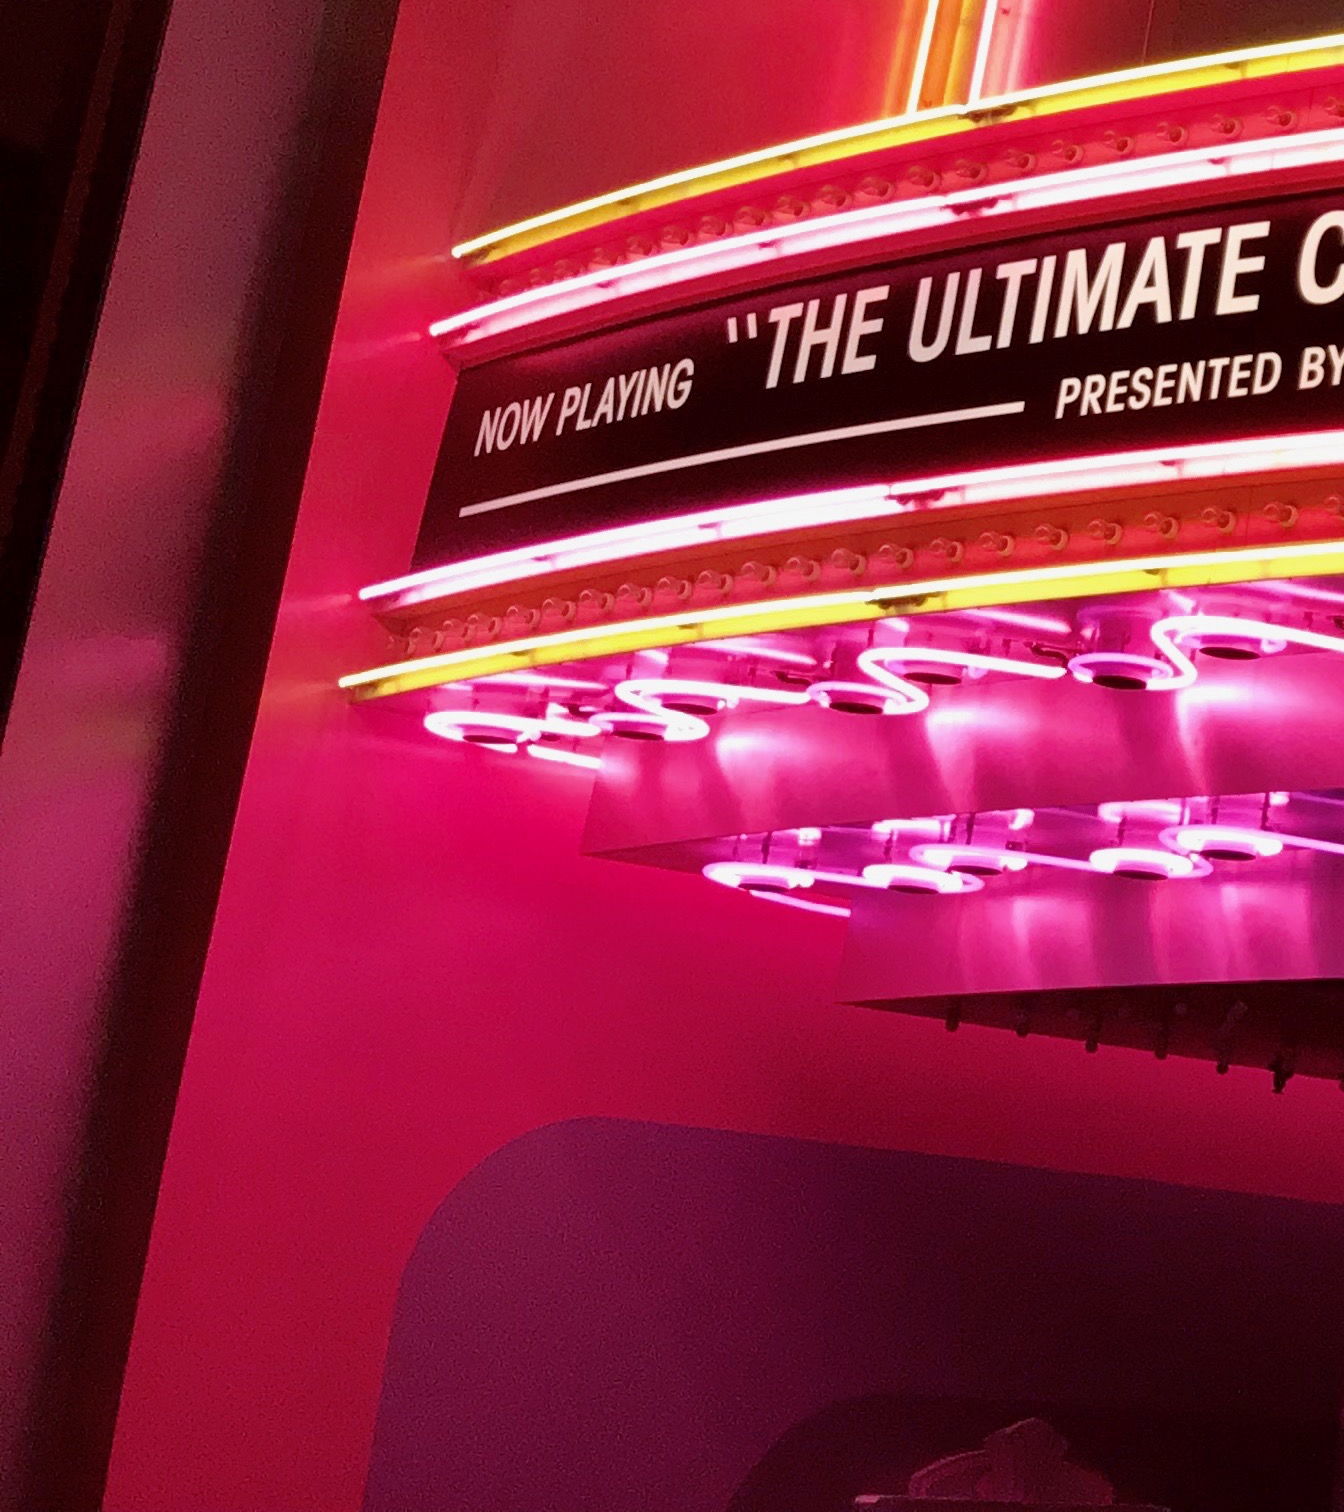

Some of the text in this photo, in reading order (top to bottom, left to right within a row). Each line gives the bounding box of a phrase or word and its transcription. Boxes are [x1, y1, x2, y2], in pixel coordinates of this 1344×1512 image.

[727, 285, 890, 389] "THE
[908, 220, 1271, 363] ULTIMATE
[474, 358, 694, 457] NOW PLAYING
[1055, 351, 1282, 419] PRESENTED
